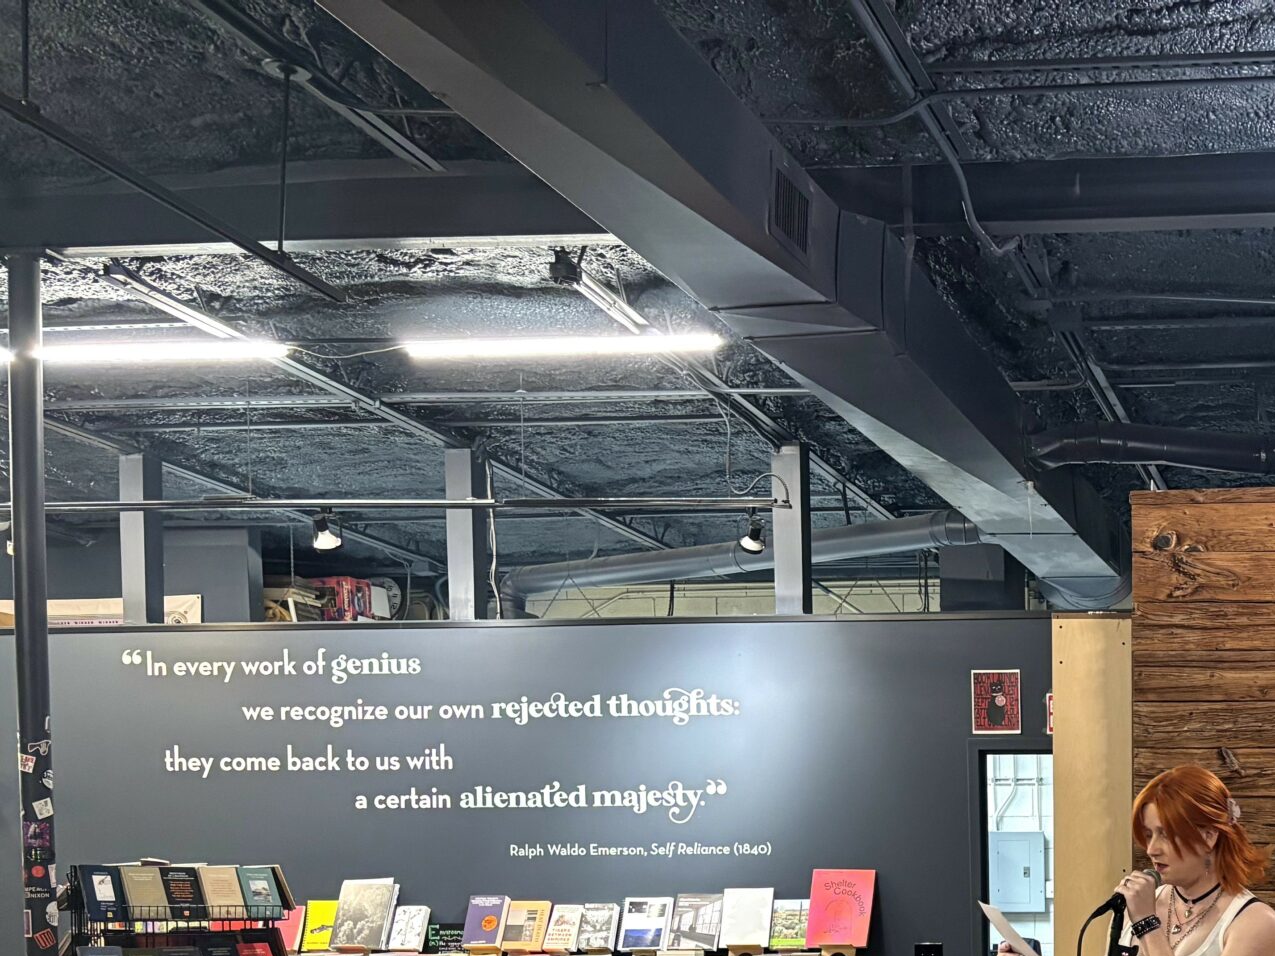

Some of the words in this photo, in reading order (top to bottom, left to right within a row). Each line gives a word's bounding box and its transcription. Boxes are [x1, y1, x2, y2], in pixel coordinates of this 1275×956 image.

[122, 649, 167, 677] “In
[173, 653, 233, 682] every
[241, 649, 296, 677] work
[303, 648, 327, 677] of
[331, 654, 422, 682] genius
[243, 700, 274, 721] we
[280, 698, 388, 728] recognize
[394, 700, 433, 721] our
[439, 700, 485, 721] own
[490, 692, 602, 723] rejected
[607, 687, 740, 725] thoughts:
[165, 748, 213, 778] they
[220, 752, 281, 772] come
[287, 745, 341, 772] back
[346, 749, 369, 772] to
[376, 752, 401, 772] us
[406, 745, 453, 772] with
[355, 790, 367, 810] a
[373, 786, 452, 810] certain
[459, 781, 588, 810] alienated
[592, 778, 728, 824] majesty.”
[509, 843, 543, 858] Ralph
[547, 843, 585, 857] Waldo
[589, 843, 647, 858] Emerson,
[650, 843, 675, 858] Self
[678, 843, 729, 857] Reliance
[733, 842, 772, 858] (1840)
[824, 880, 856, 890] Shelter
[834, 887, 866, 917] Cookbook
